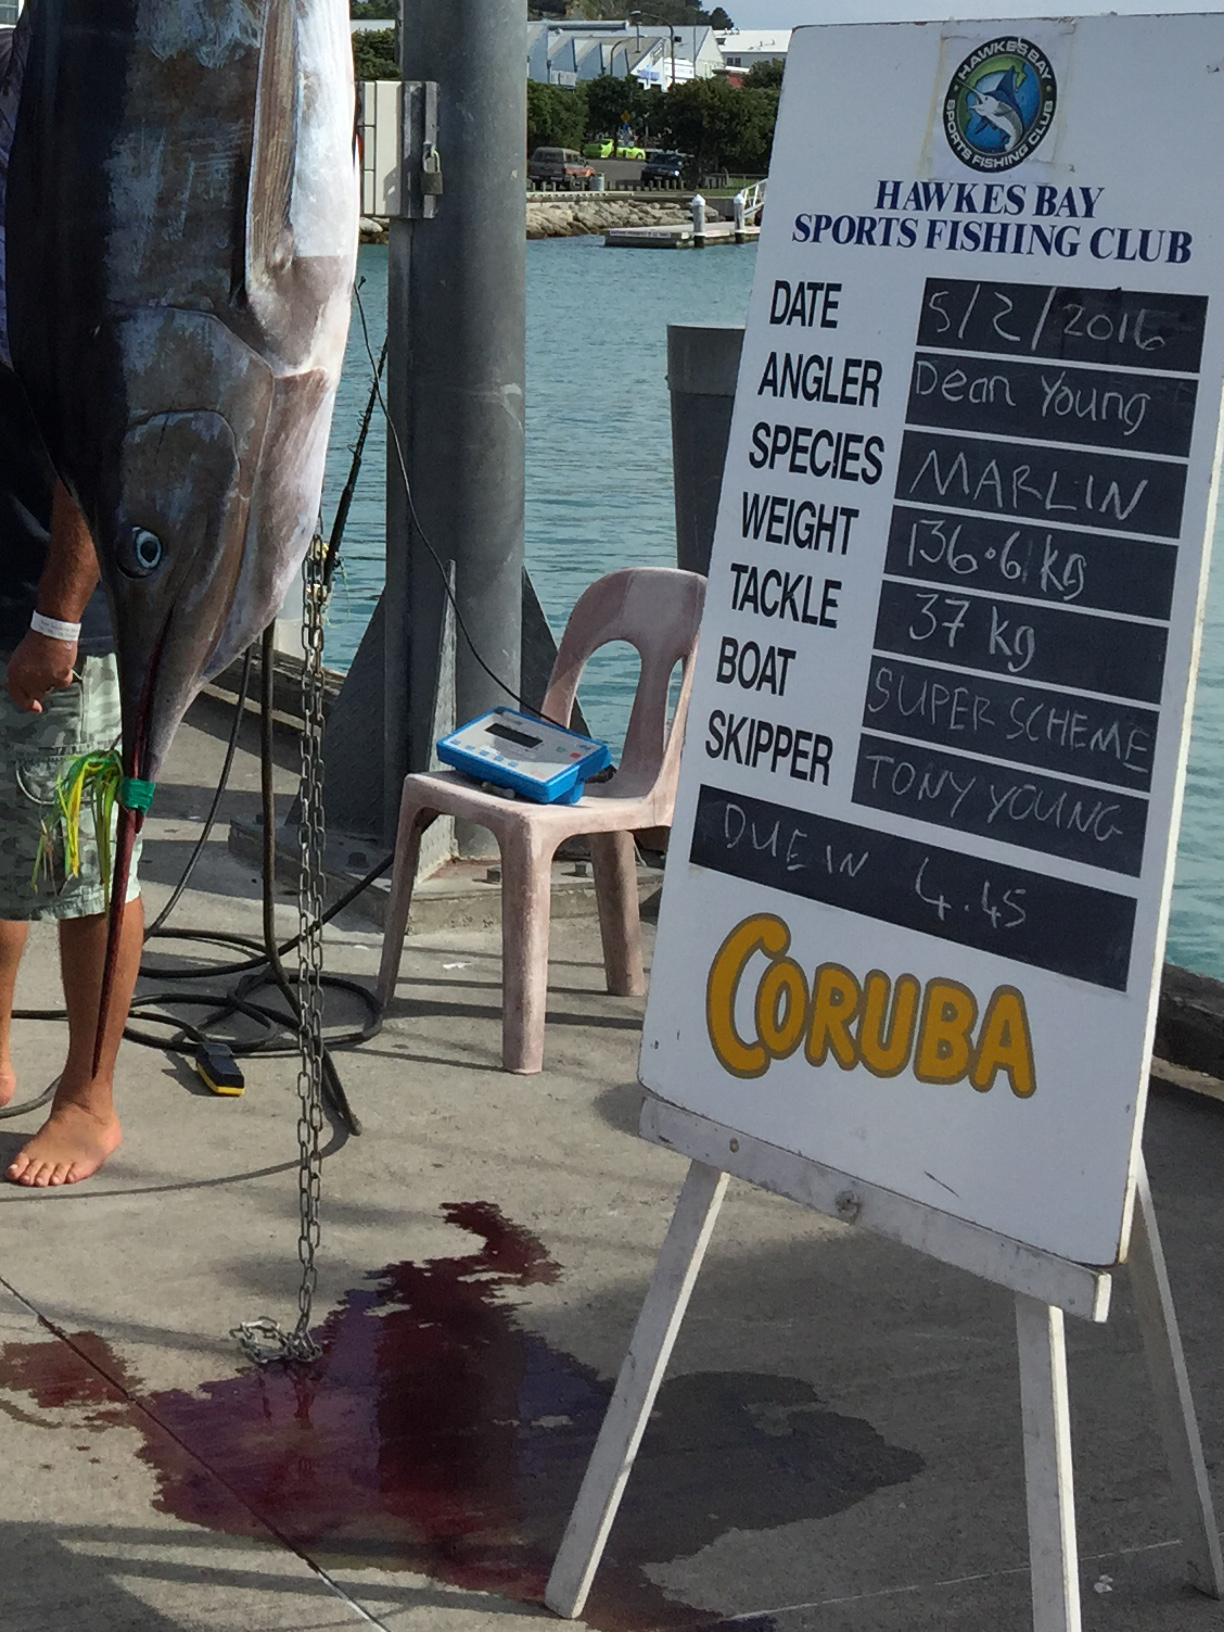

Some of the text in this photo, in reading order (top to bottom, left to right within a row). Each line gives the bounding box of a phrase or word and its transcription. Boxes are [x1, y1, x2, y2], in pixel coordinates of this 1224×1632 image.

[1027, 50, 1052, 79] BAY
[946, 99, 1054, 169] SPORTS FISHING CLUB
[874, 180, 1104, 218] HAWKES BAY
[792, 213, 1193, 264] SPORTS FISHING CLUB
[769, 279, 842, 329] DATE
[757, 351, 883, 408] ANGLER
[916, 360, 1151, 435] Dean Young
[749, 421, 885, 485] SPECIES
[909, 449, 1149, 520] MARLIN
[741, 491, 859, 555] WEIGHT
[730, 563, 842, 629] TACKLE
[909, 593, 970, 648] 37
[716, 636, 797, 697] BOAT
[705, 709, 834, 786] SKIPPER
[868, 667, 1150, 774] SUPER SCHEME
[866, 755, 1123, 841] TONY YOUNG
[724, 803, 808, 871] DUE
[826, 845, 869, 877] IN
